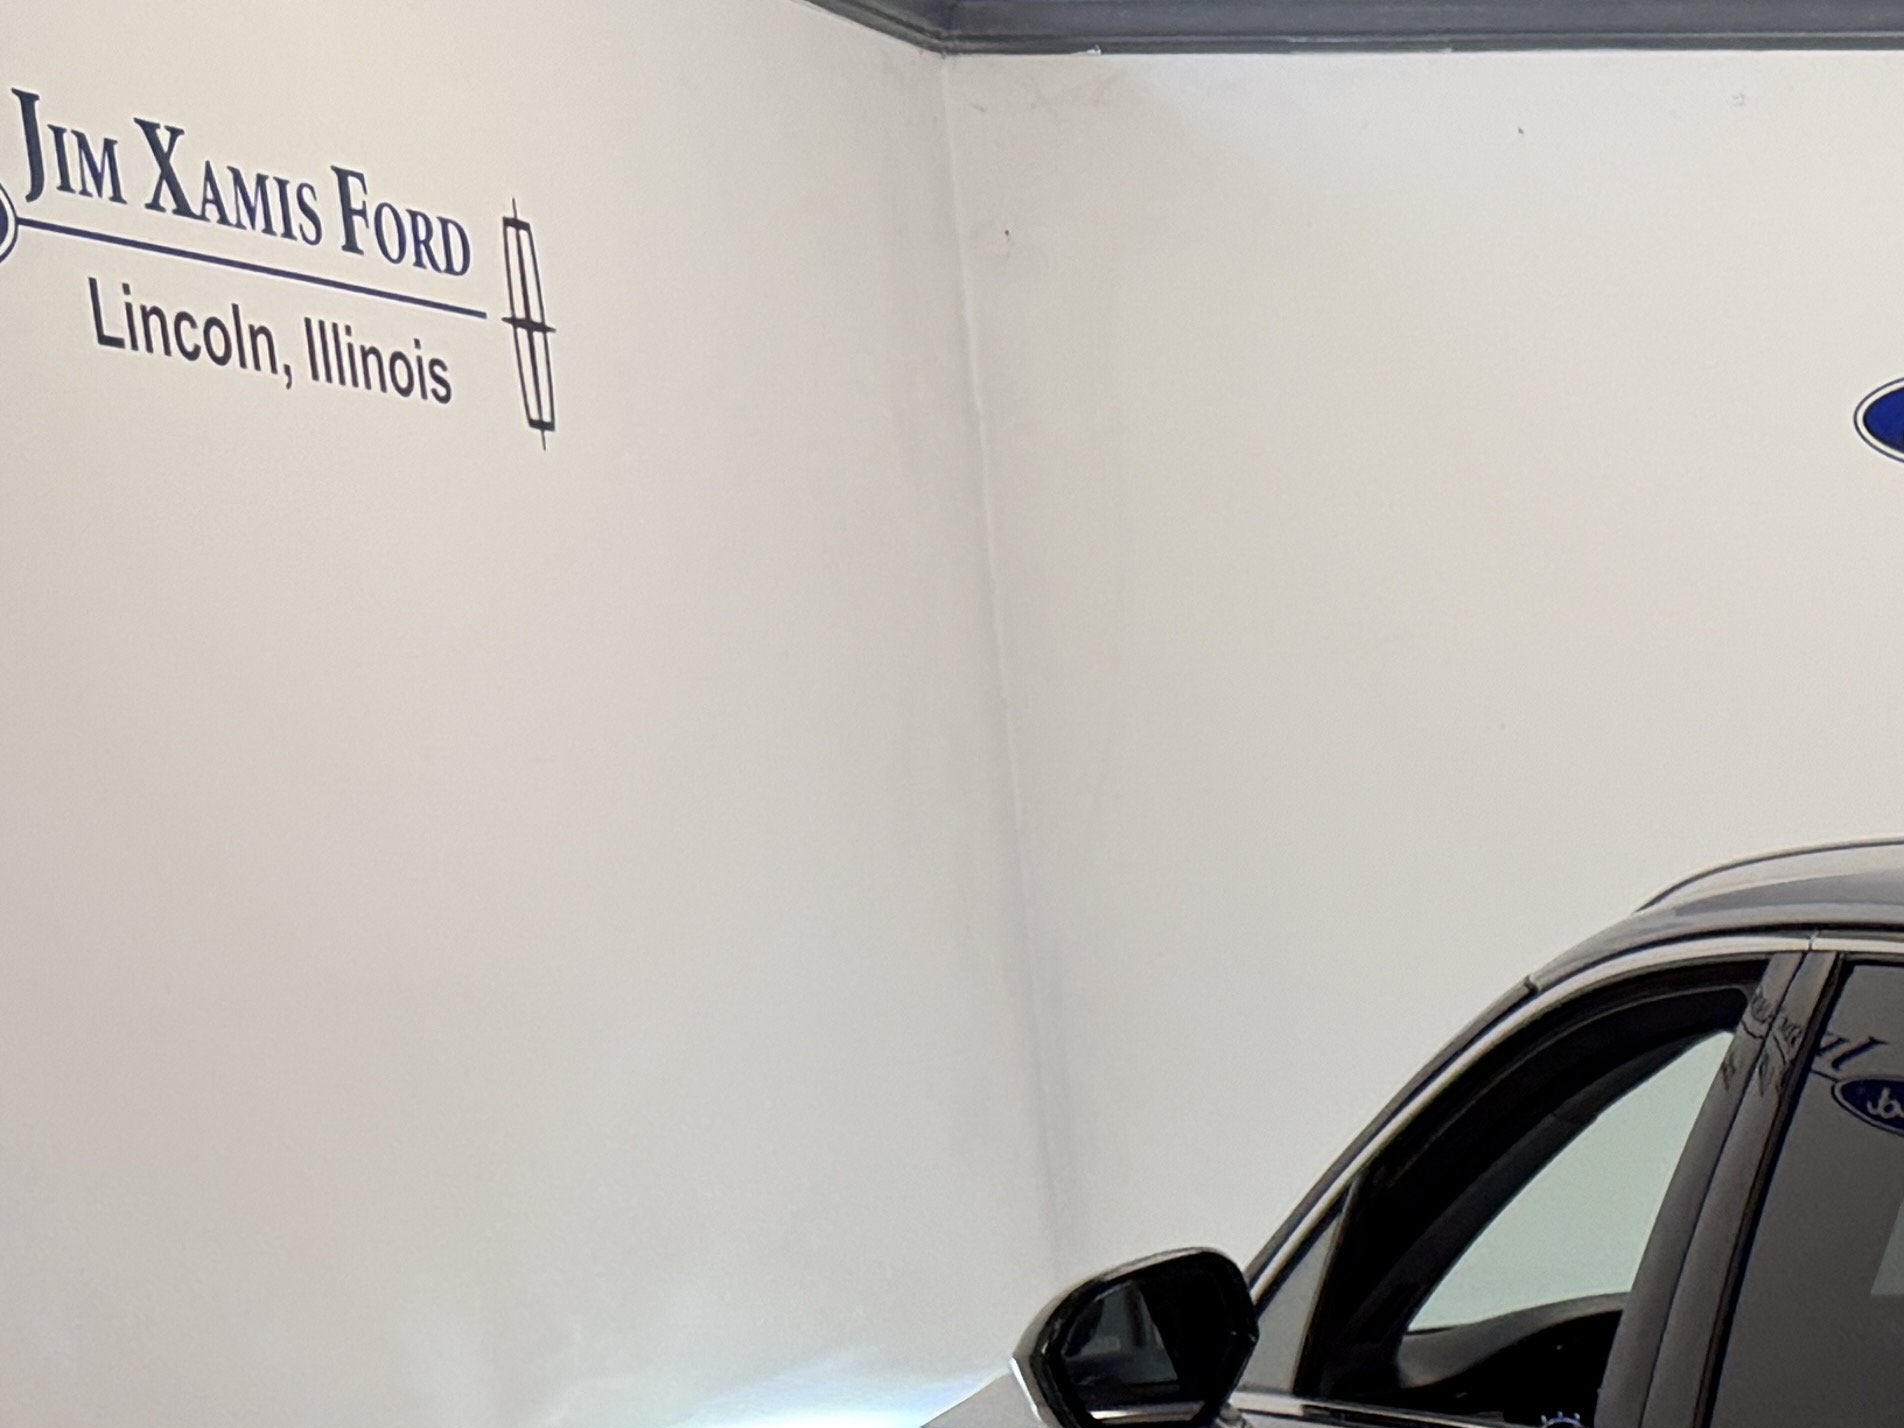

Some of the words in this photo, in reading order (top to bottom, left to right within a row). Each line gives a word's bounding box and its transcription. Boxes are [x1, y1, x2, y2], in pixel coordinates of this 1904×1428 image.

[12, 87, 128, 205] JIM
[133, 117, 323, 246] XAMIS
[330, 165, 471, 277] FORD
[88, 276, 293, 390] Lincoln,
[304, 316, 453, 405] Illinois
